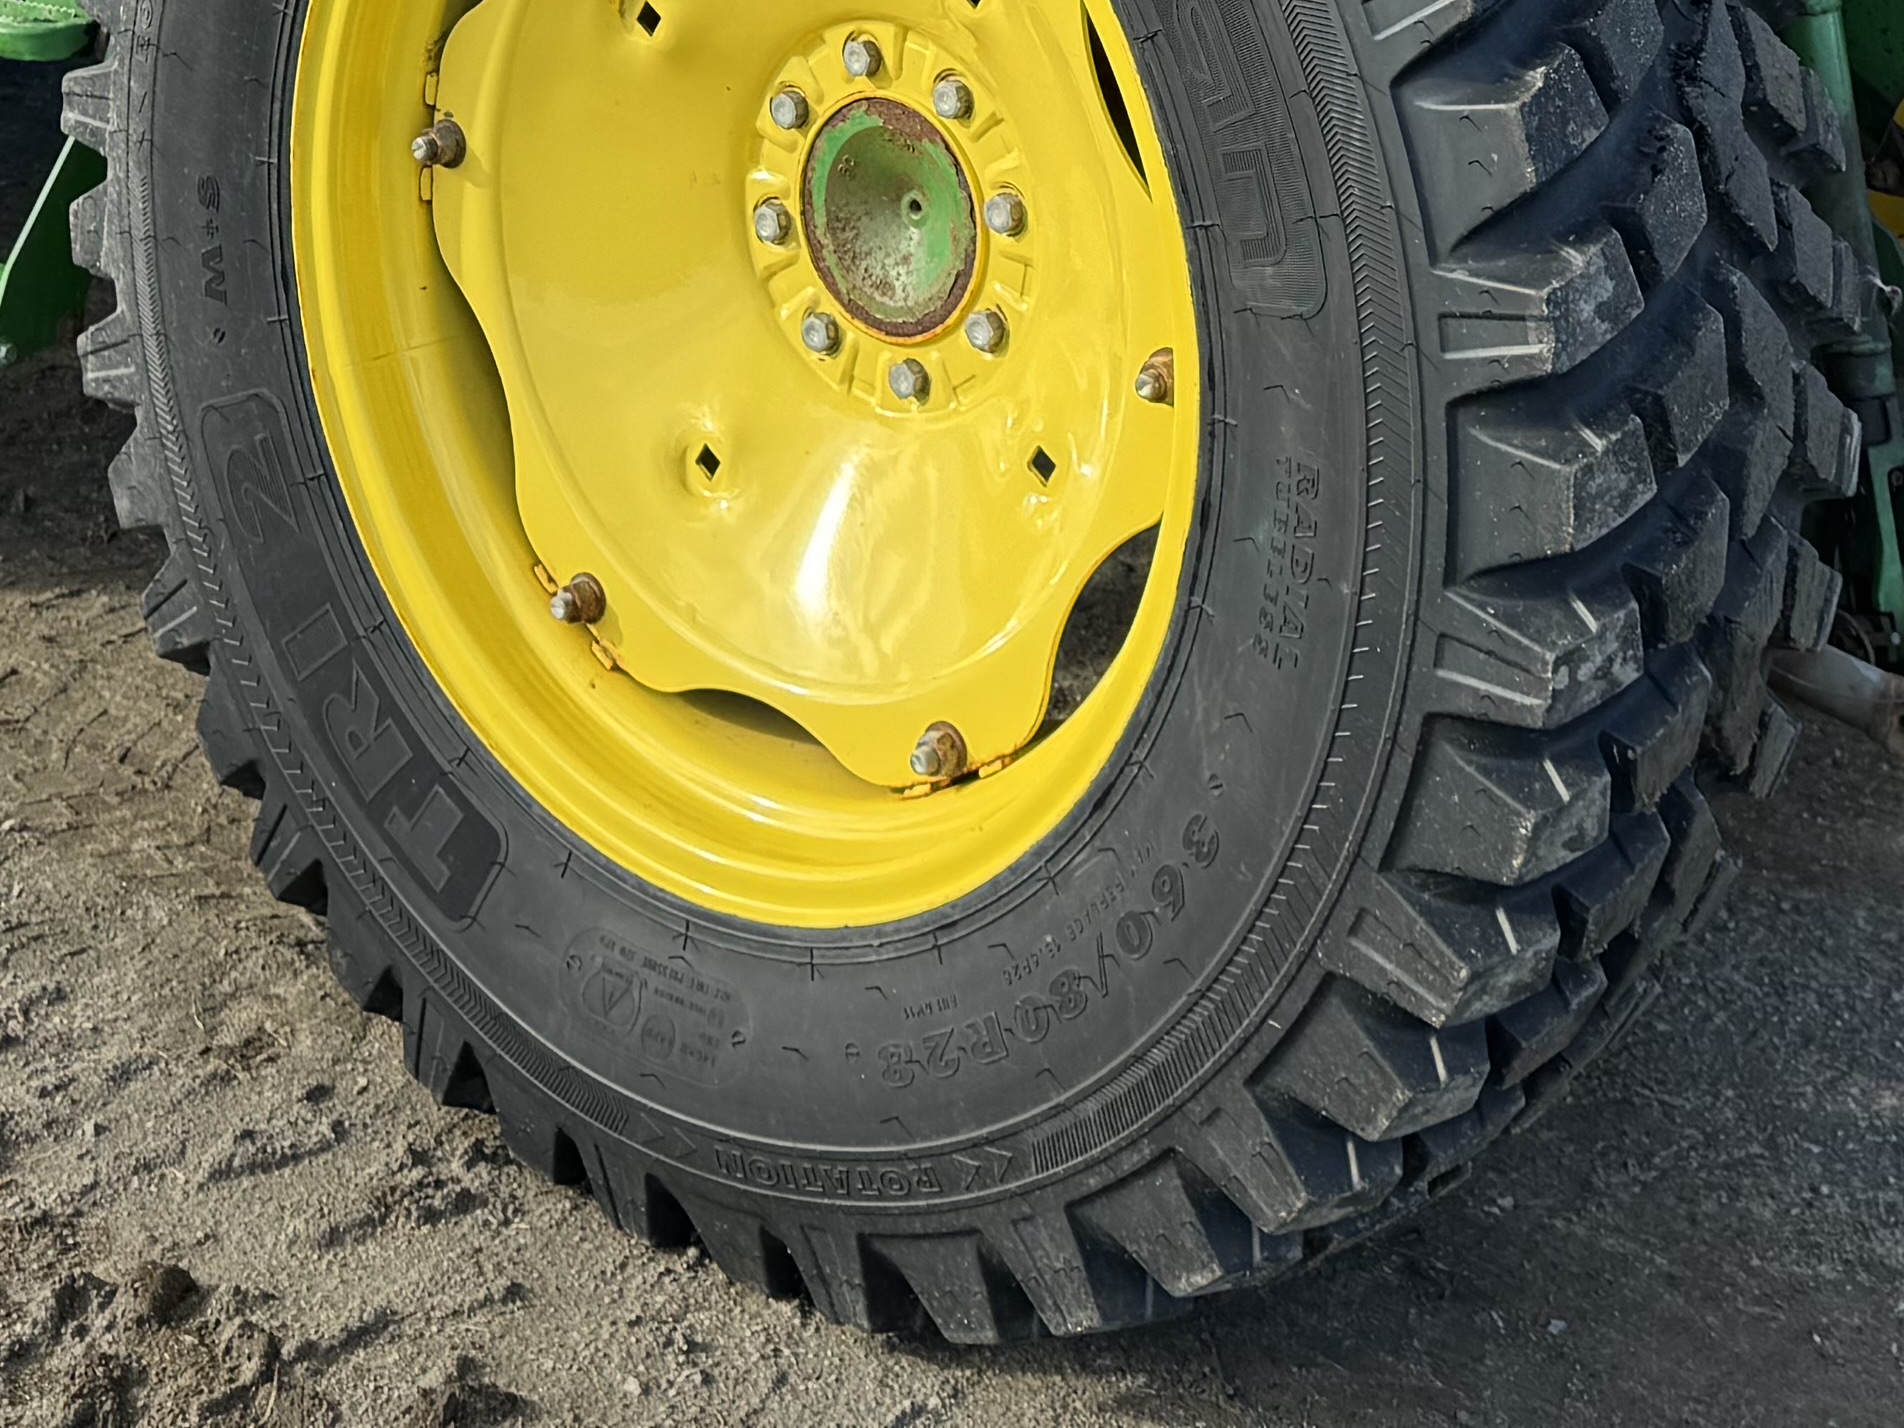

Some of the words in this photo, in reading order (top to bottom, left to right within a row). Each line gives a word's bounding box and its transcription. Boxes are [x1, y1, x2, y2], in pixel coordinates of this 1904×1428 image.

[199, 173, 229, 306] M+S
[1274, 462, 1320, 671] RADIAL
[282, 603, 467, 893] TRI
[876, 812, 1220, 1088] 360/80R28
[713, 1147, 943, 1197] ROTATION
